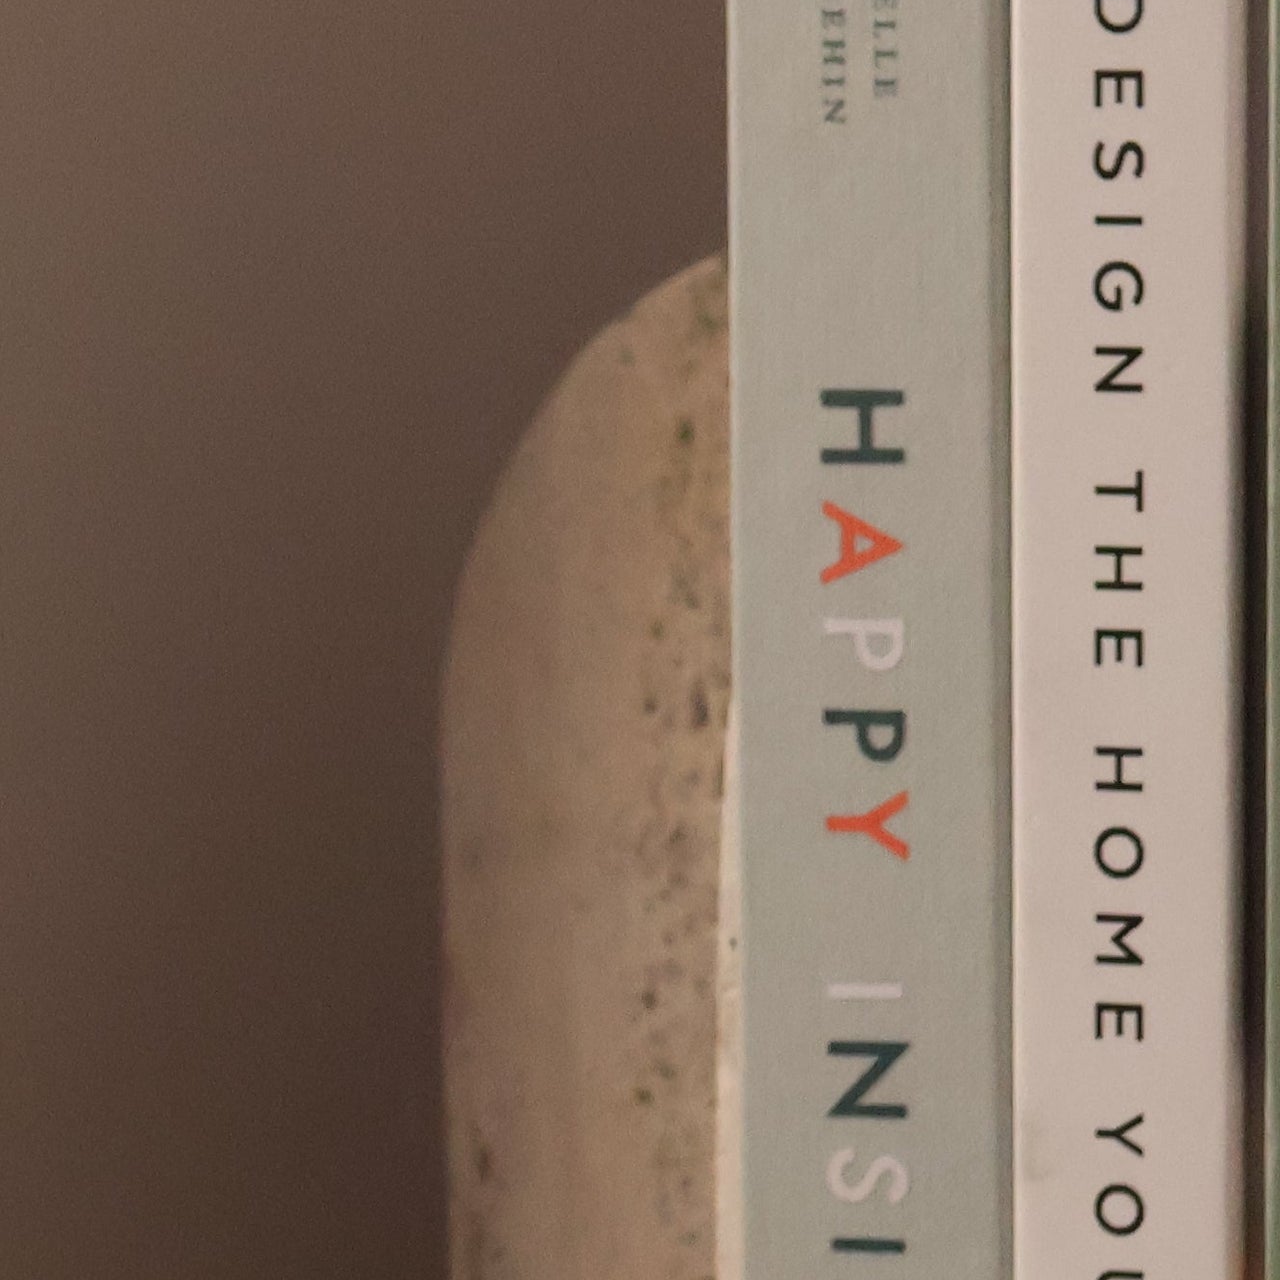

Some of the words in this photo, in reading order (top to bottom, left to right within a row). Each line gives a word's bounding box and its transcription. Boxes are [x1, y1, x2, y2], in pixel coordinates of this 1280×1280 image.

[820, 389, 909, 859] HAPPY
[1094, 470, 1144, 667] THE
[1094, 746, 1145, 1042] HOME
